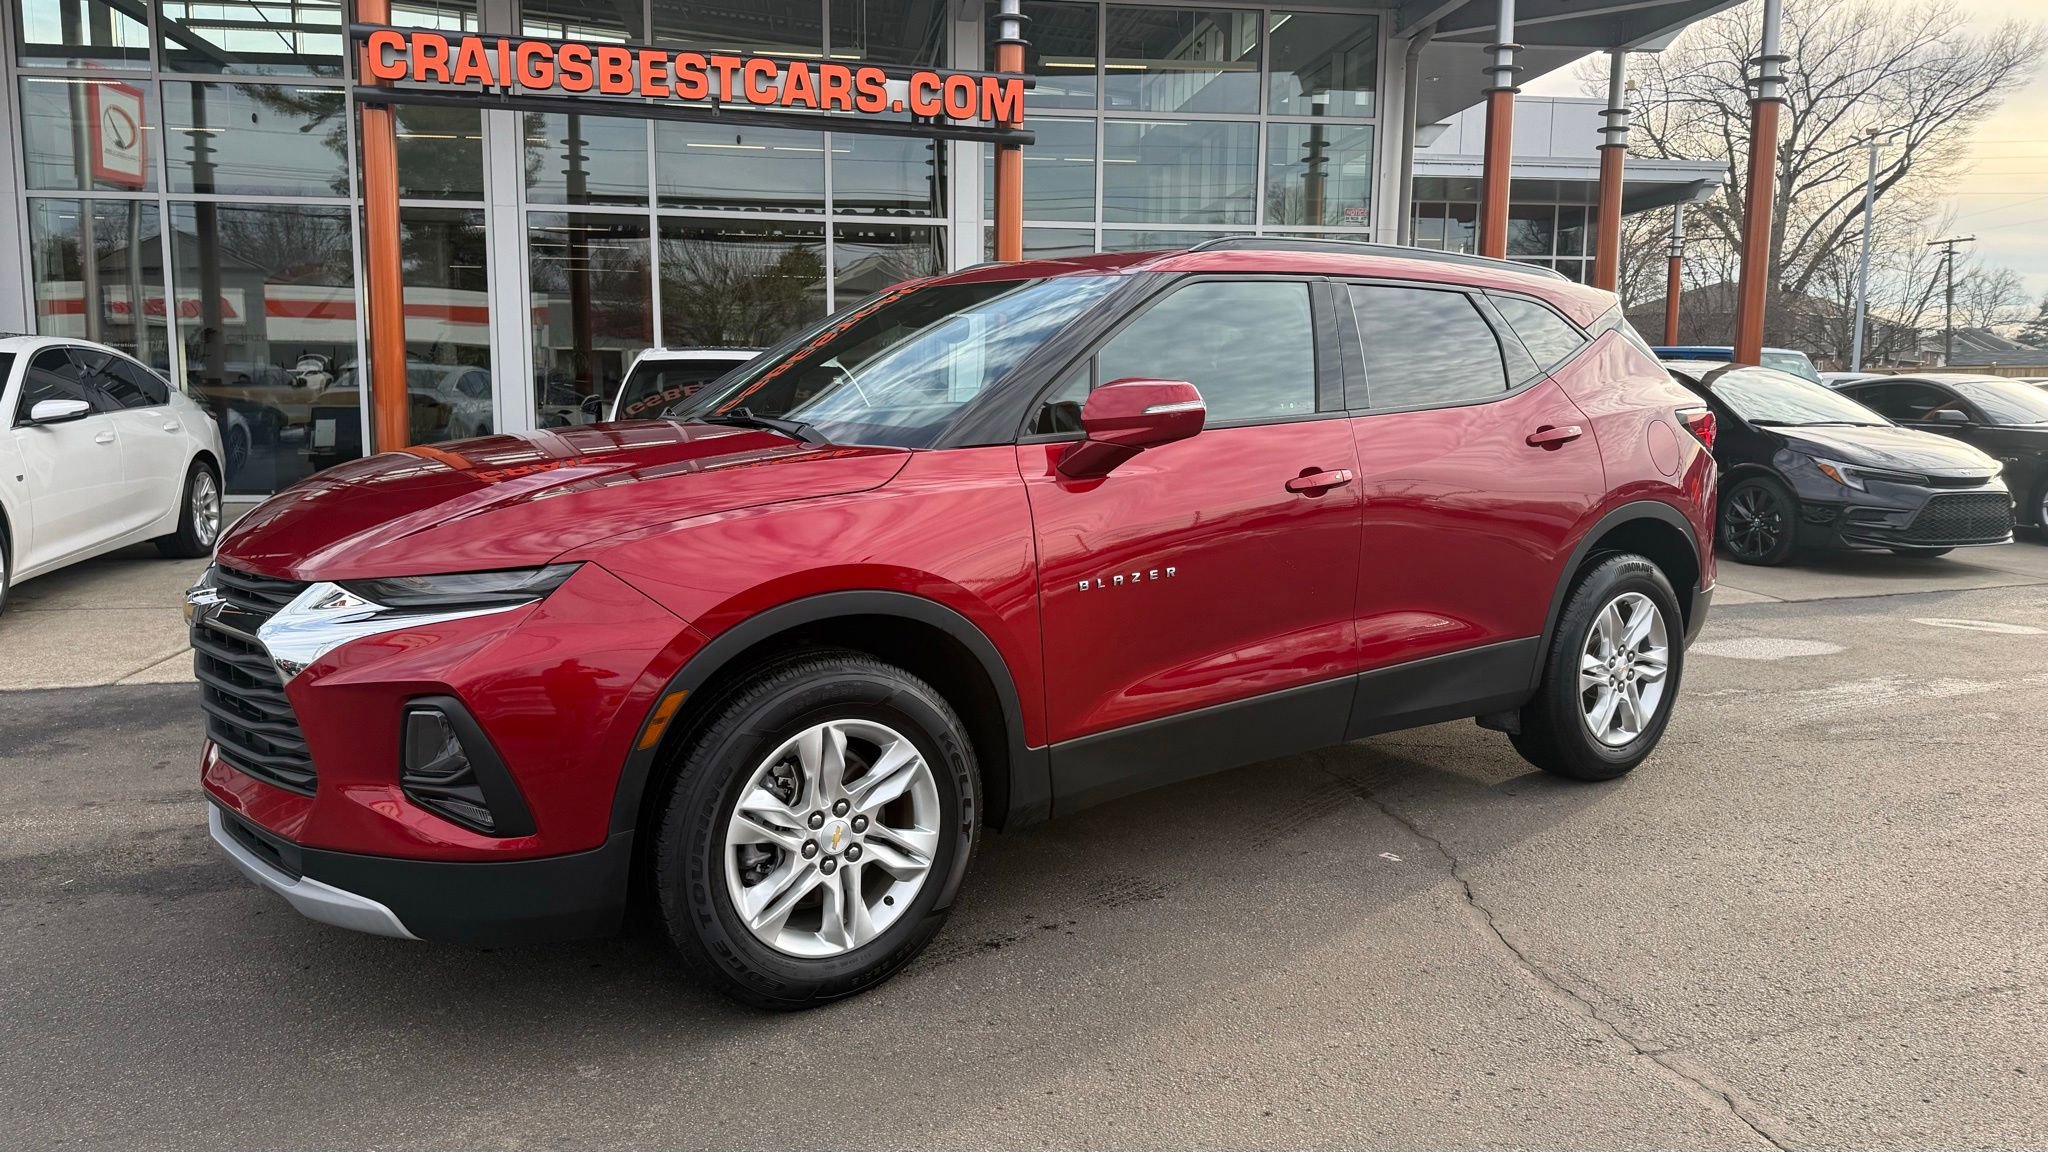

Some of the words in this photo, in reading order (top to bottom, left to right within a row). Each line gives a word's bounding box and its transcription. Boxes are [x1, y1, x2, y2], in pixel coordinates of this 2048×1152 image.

[367, 29, 1025, 123] CRAIGSBESTCARS.COM
[1078, 567, 1176, 591] BLAZER
[938, 731, 972, 843] KELLY
